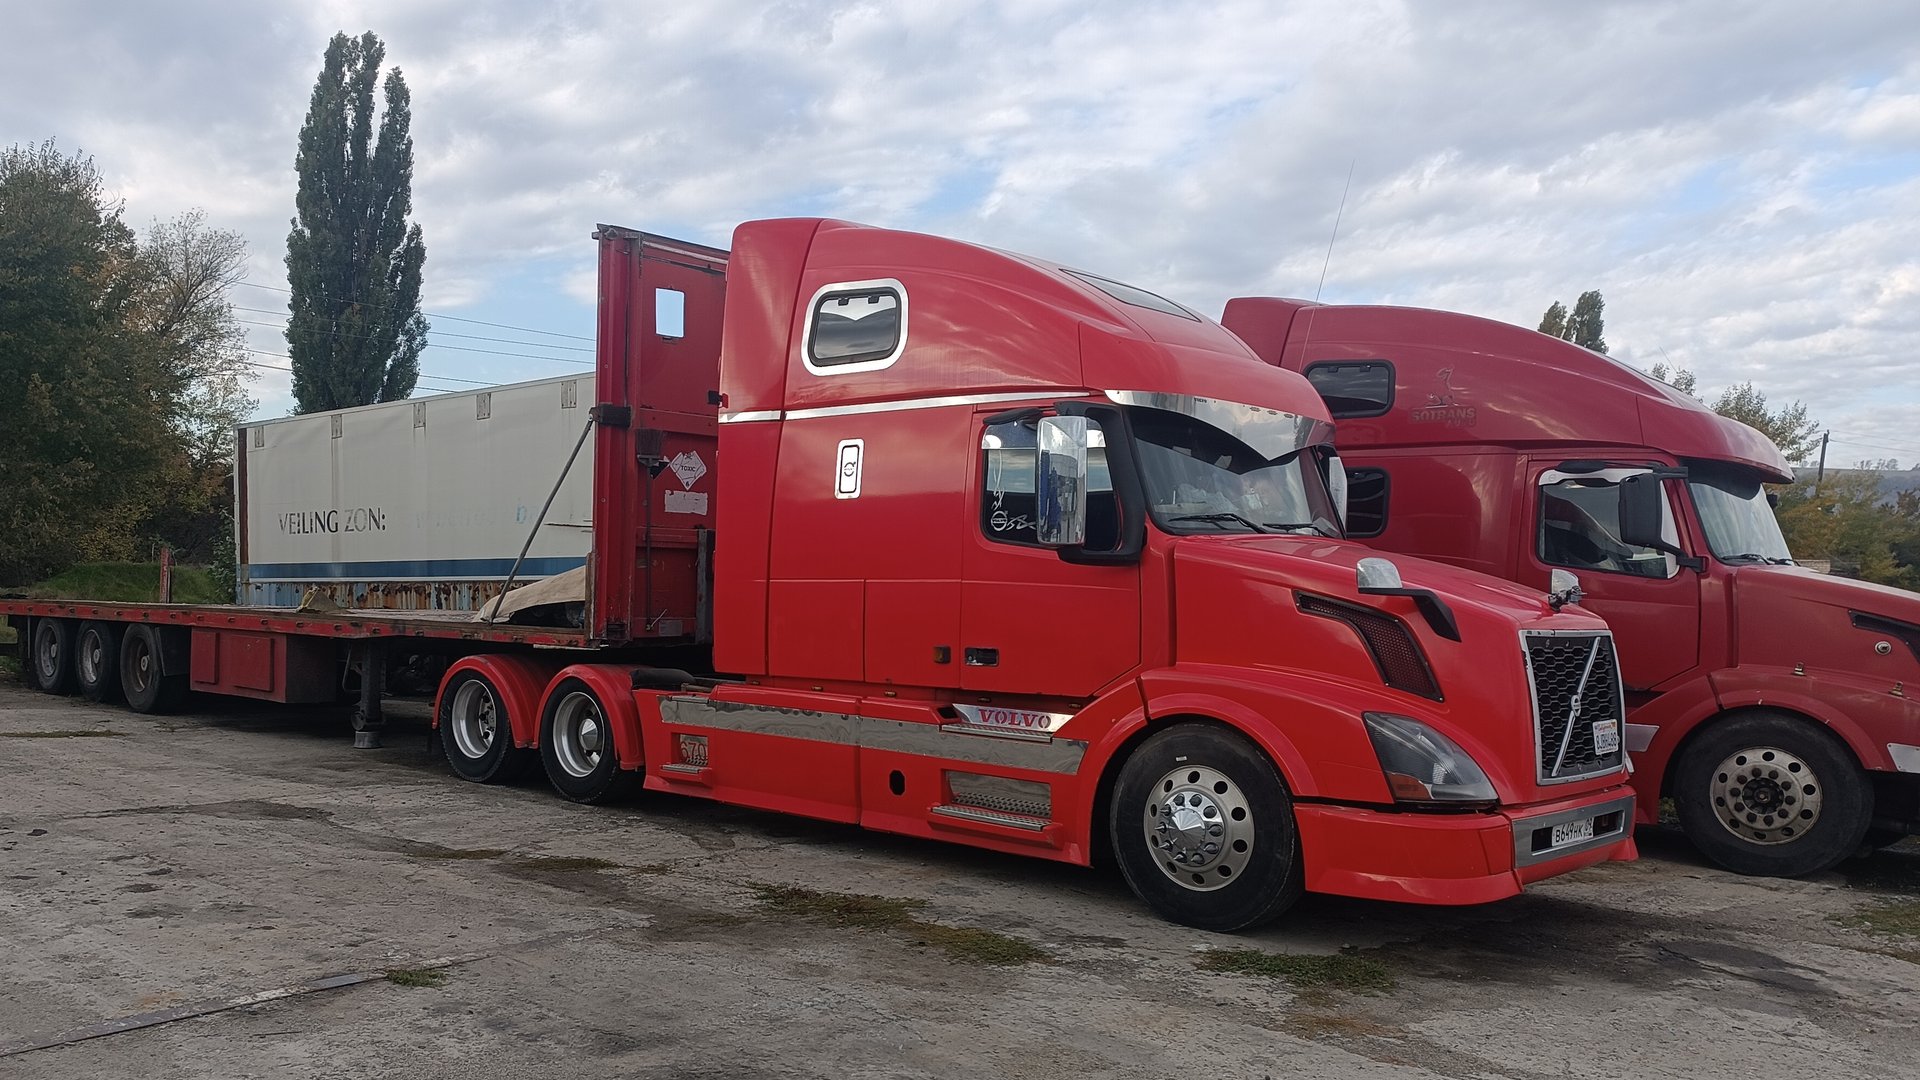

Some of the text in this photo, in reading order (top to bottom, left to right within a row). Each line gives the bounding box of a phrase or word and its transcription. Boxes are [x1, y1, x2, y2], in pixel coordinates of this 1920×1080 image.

[1411, 407, 1476, 421] SOTRANS
[278, 510, 339, 535] VEILING
[978, 708, 1052, 729] VOLVO
[680, 741, 707, 762] 670
